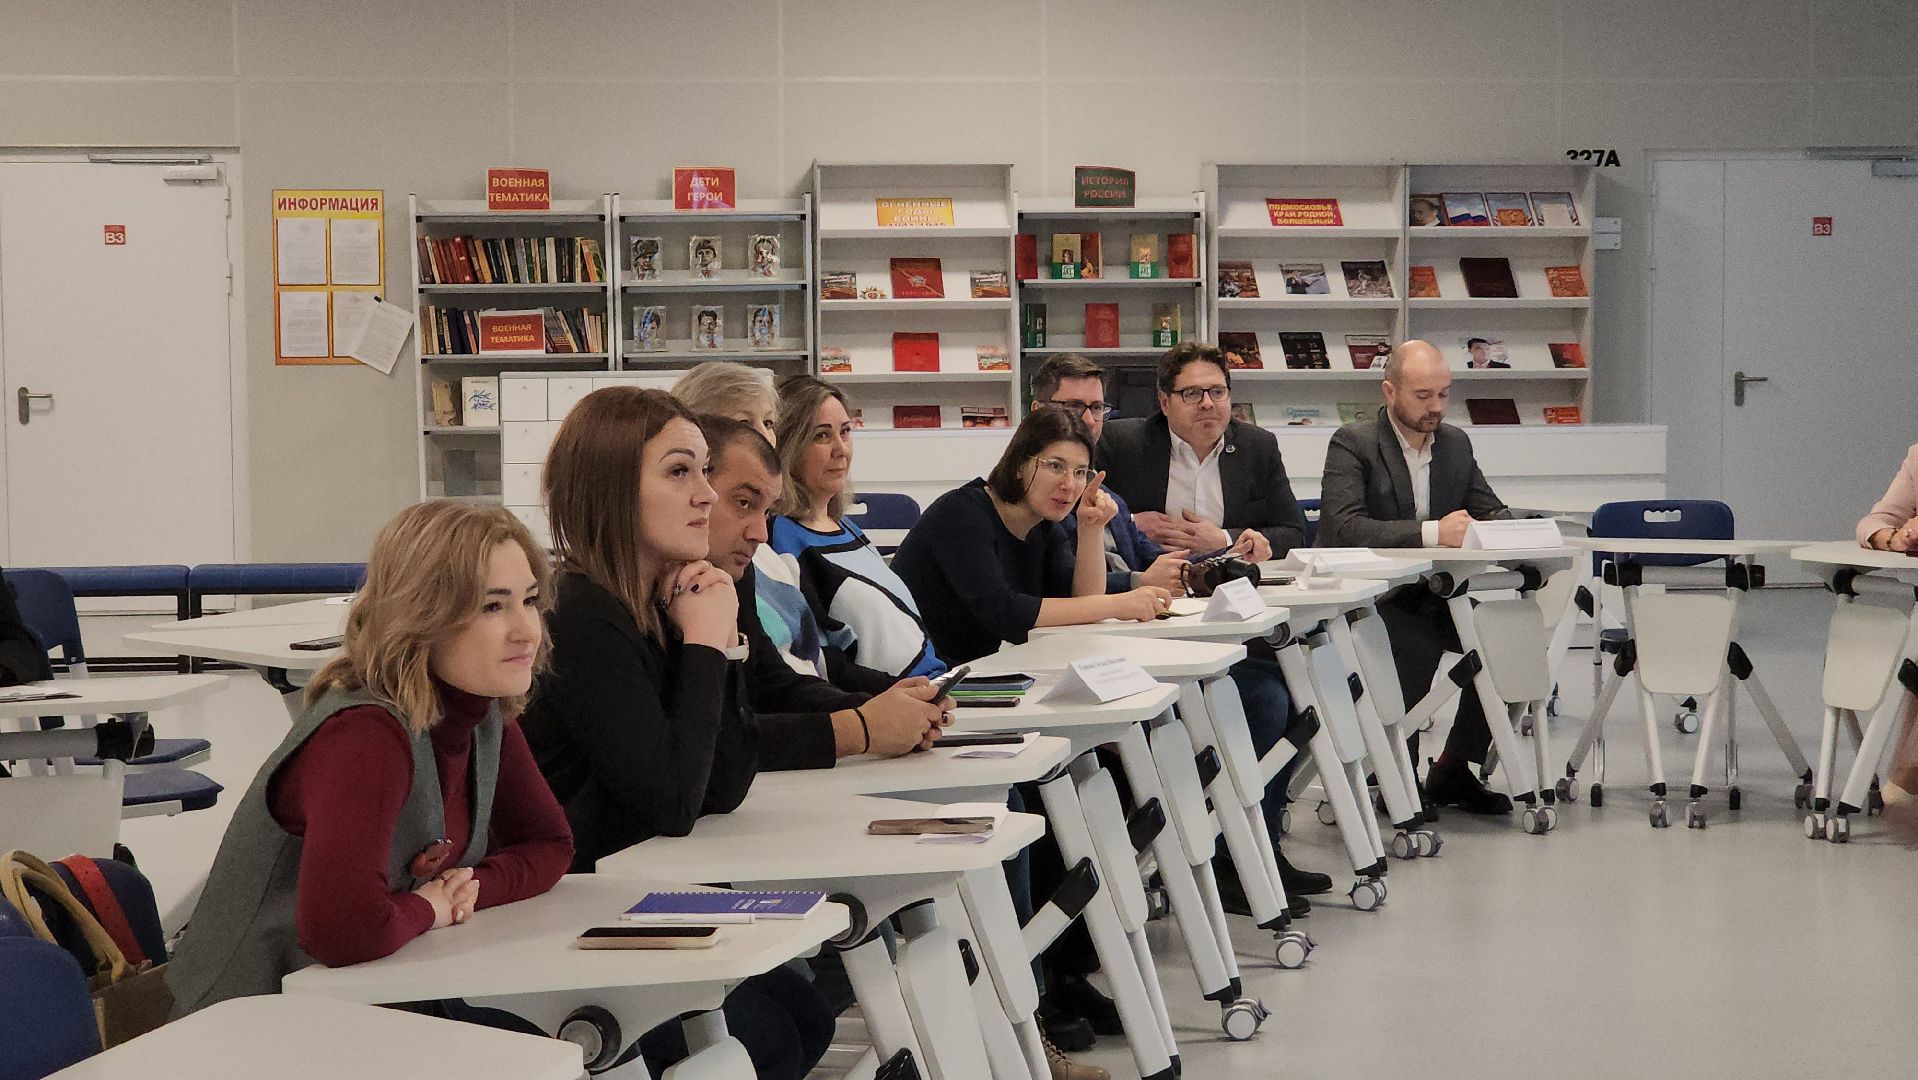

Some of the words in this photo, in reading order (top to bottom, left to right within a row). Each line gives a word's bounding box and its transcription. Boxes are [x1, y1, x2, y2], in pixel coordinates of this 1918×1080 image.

[492, 177, 545, 187] ВОЕННАЯ
[689, 176, 719, 188] ДЕТИ
[1081, 175, 1129, 185] ИСТОРИЯ
[488, 192, 549, 202] ТЕМАТИКА
[687, 191, 723, 201] ГЕРОИ
[1083, 189, 1126, 199] РОССИИ
[277, 197, 379, 213] ИНФОРМАЦИЯ
[105, 232, 125, 243] В3
[492, 323, 532, 333] ВОЕННАЯ
[490, 334, 536, 344] ТЕМАТИКА
